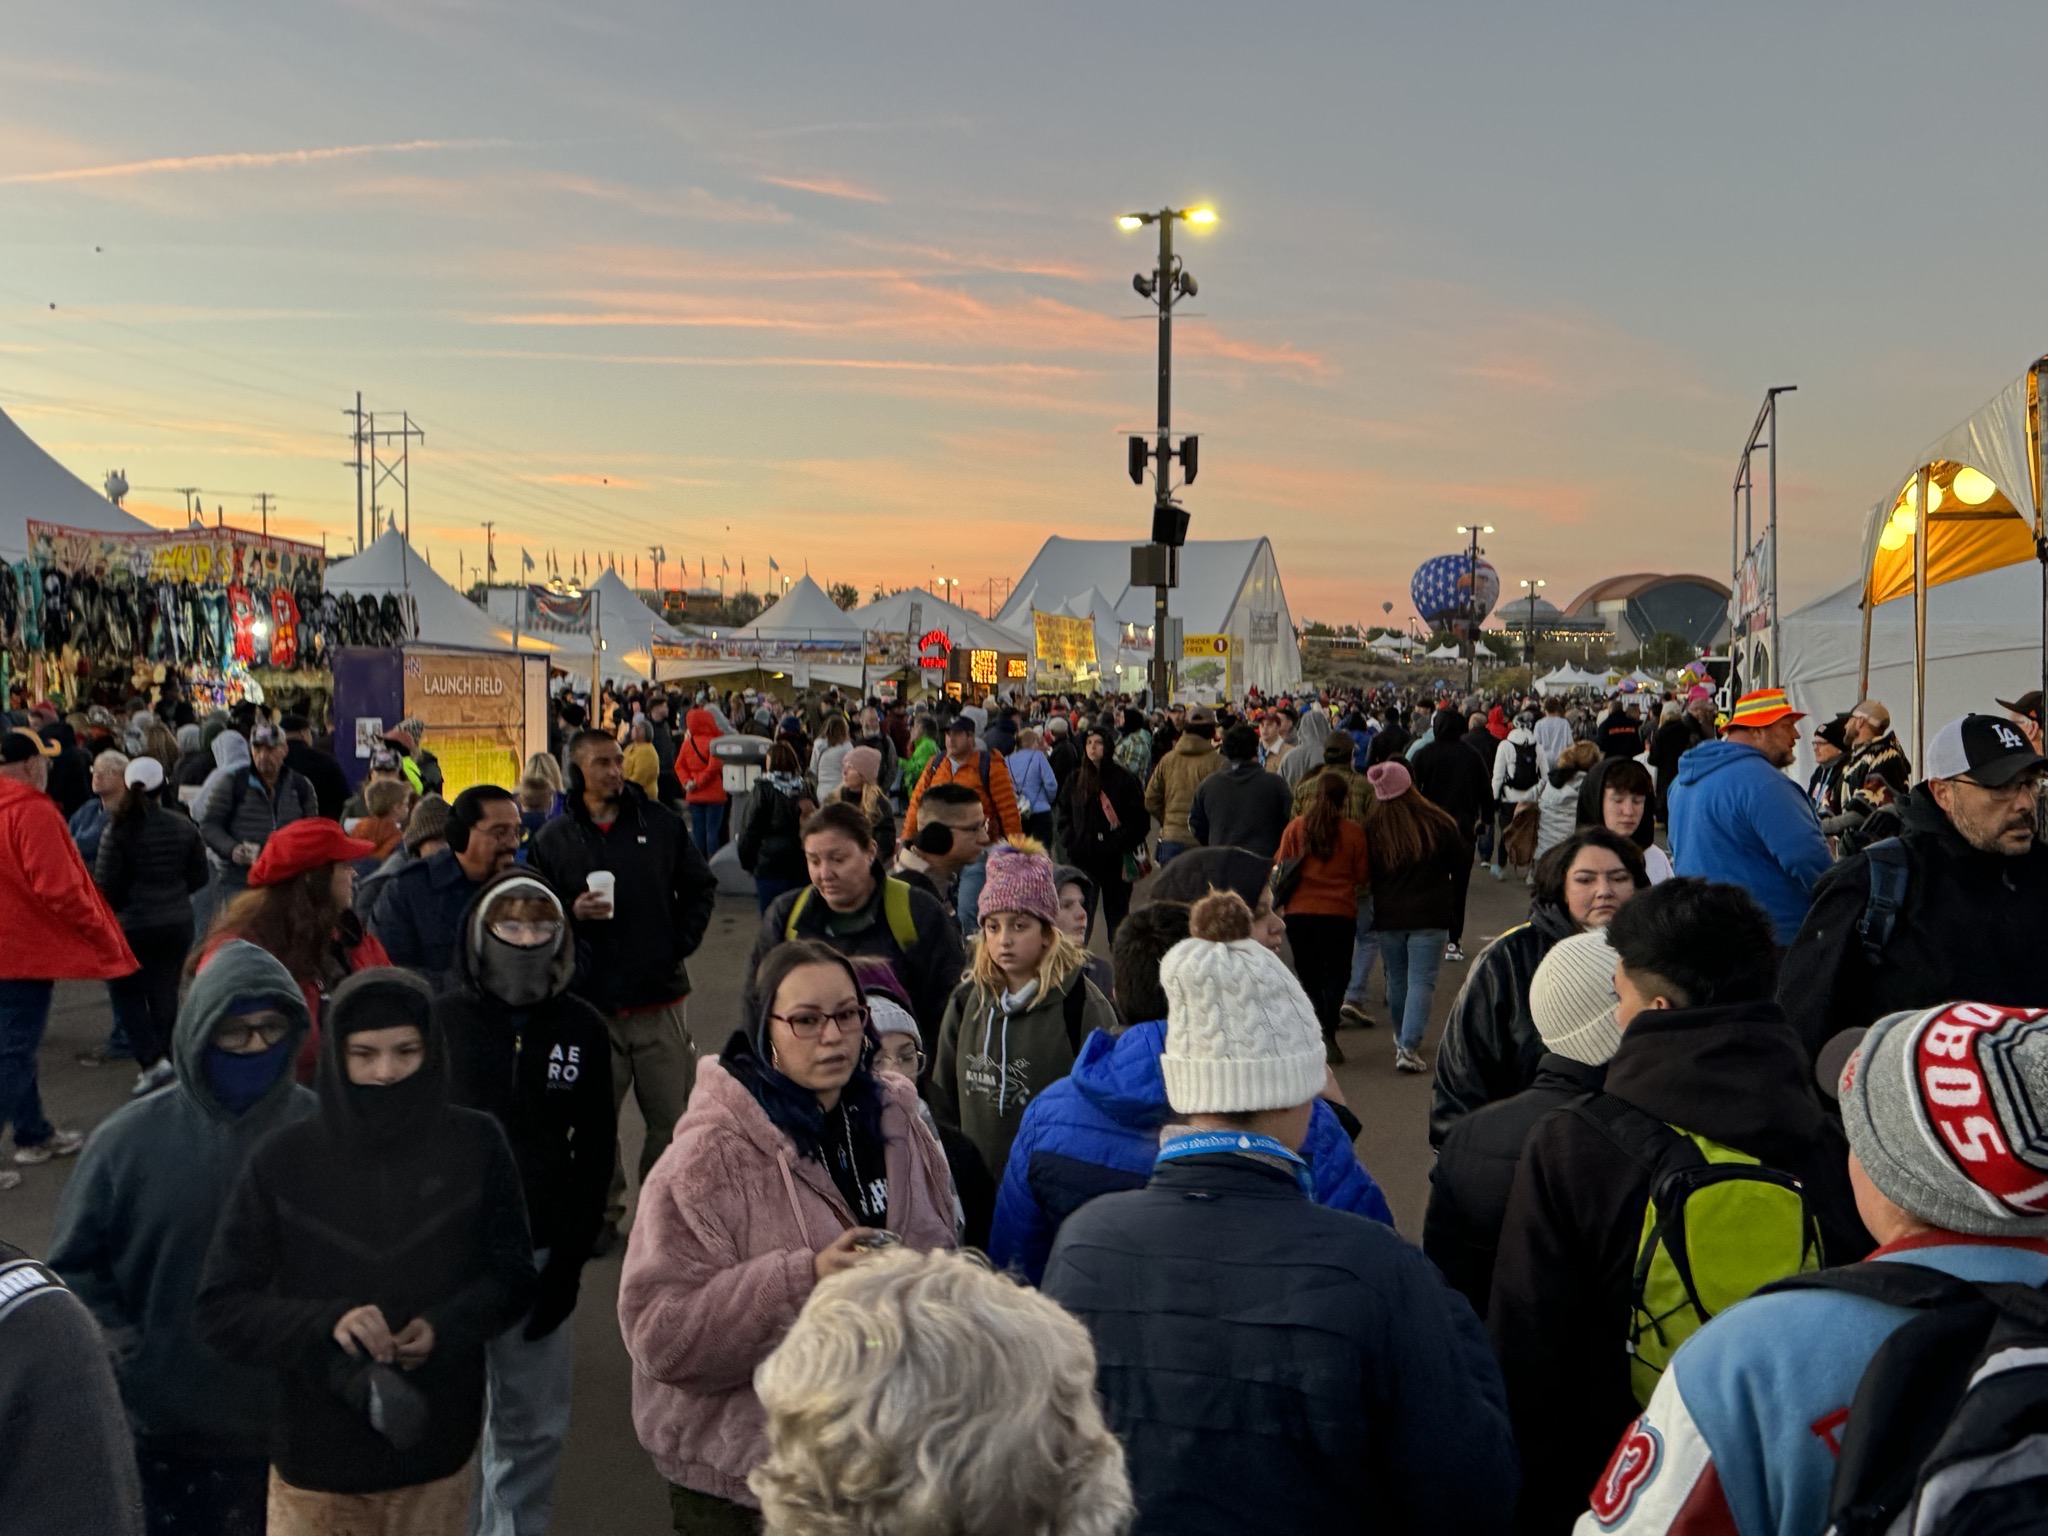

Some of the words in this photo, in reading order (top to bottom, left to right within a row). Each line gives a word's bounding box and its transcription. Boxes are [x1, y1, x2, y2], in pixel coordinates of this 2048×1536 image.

[424, 674, 472, 696] LAUNCH
[474, 675, 503, 696] FIELD
[1991, 723, 2023, 748] LA
[1925, 1003, 2041, 1162] OBOS
